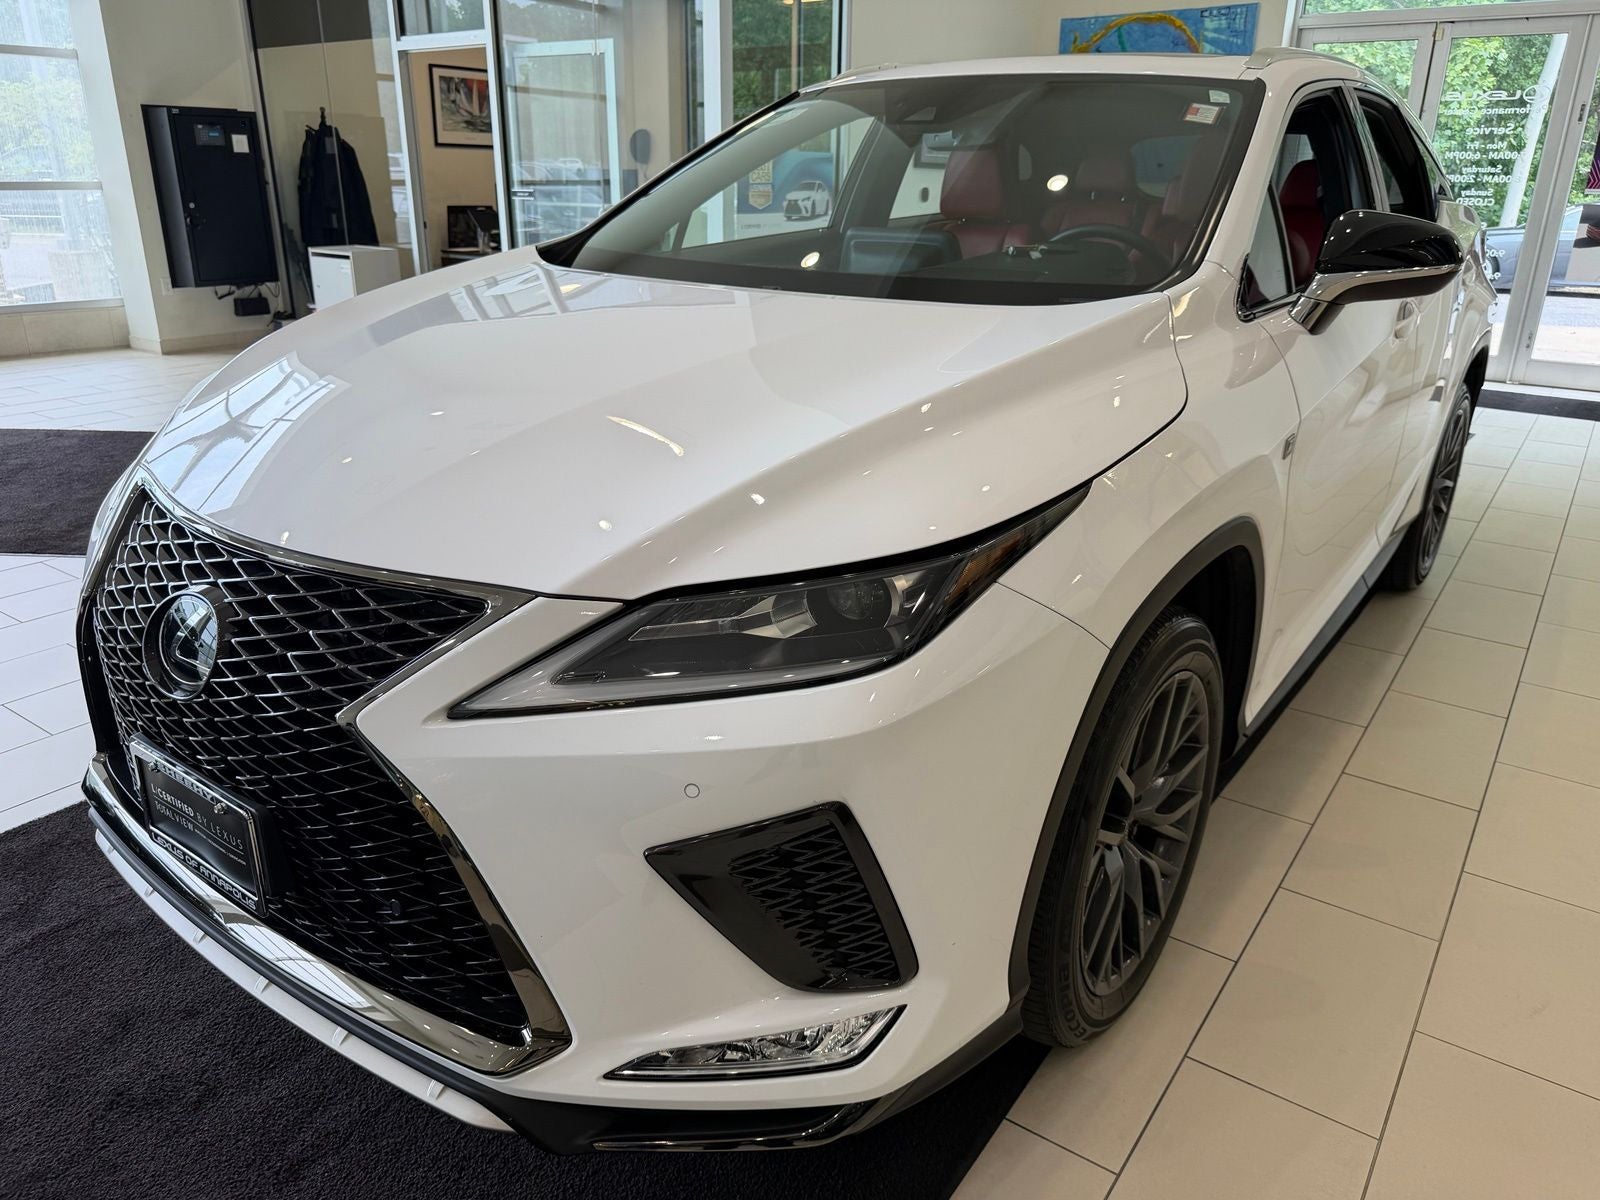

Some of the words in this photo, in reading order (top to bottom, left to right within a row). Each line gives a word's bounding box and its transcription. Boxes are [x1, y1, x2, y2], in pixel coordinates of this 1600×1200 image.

[196, 812, 207, 827] BY
[211, 822, 243, 849] LEXUS
[152, 832, 184, 860] LEXUS
[185, 855, 199, 868] OF
[200, 865, 257, 911] ANNAPOLIS
